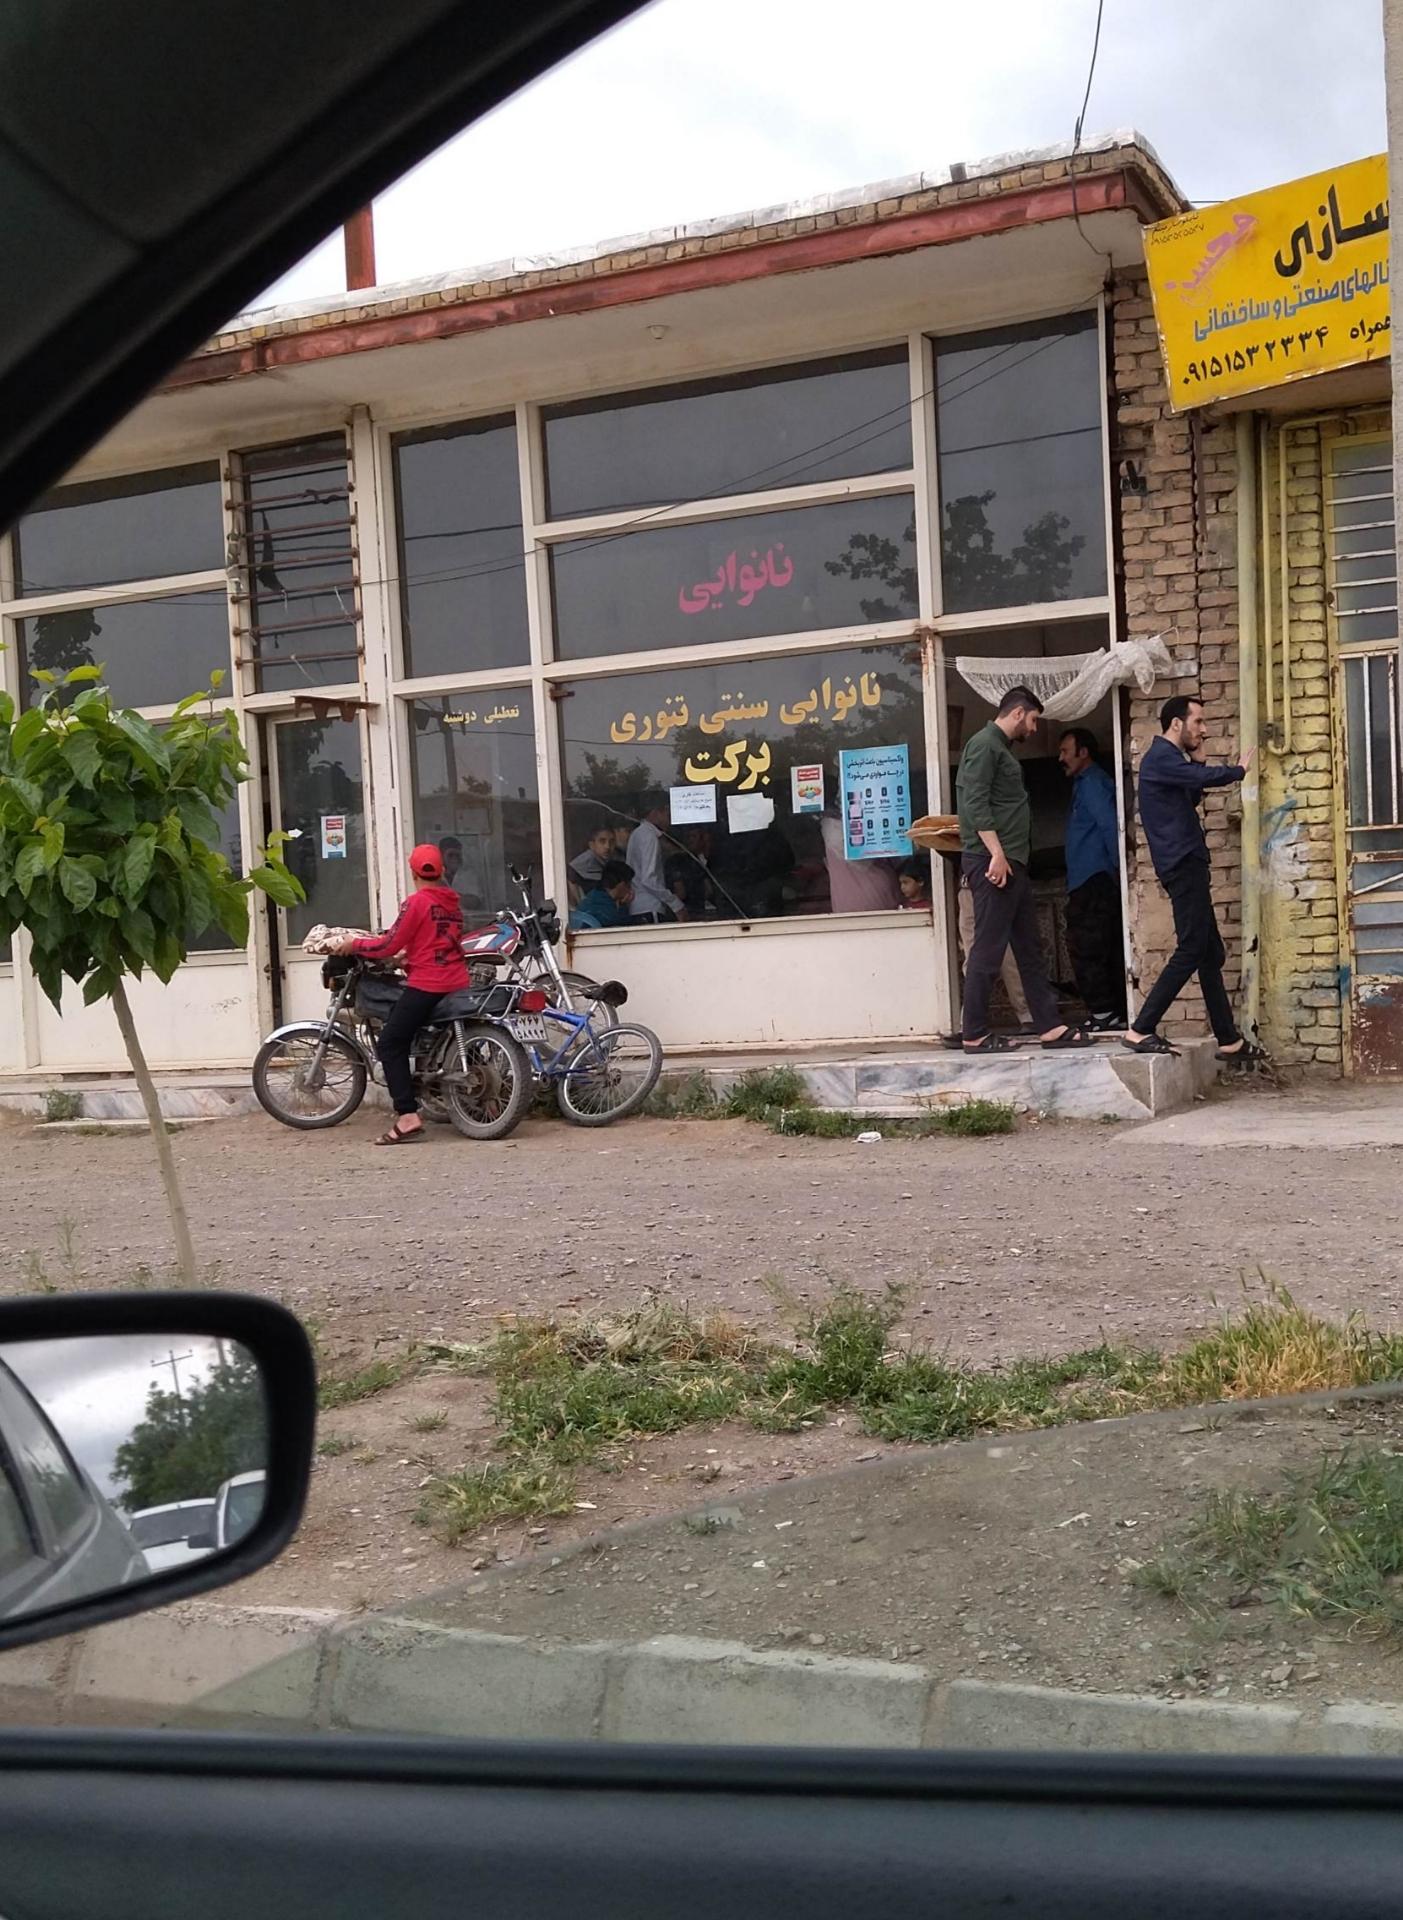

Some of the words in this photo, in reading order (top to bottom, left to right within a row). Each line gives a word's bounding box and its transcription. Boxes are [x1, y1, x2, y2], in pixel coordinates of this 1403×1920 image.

[1194, 298, 1270, 342] ساختمانی
[1272, 299, 1282, 320] و
[1284, 280, 1340, 318] صنعتی
[678, 542, 795, 614] نانوایی
[443, 709, 477, 727] دوشنبه
[483, 704, 520, 724] تعطیلی
[610, 694, 689, 743] تنوری
[699, 691, 768, 734] سنتی
[779, 671, 881, 724] نانوایی
[684, 740, 772, 790] برکت
